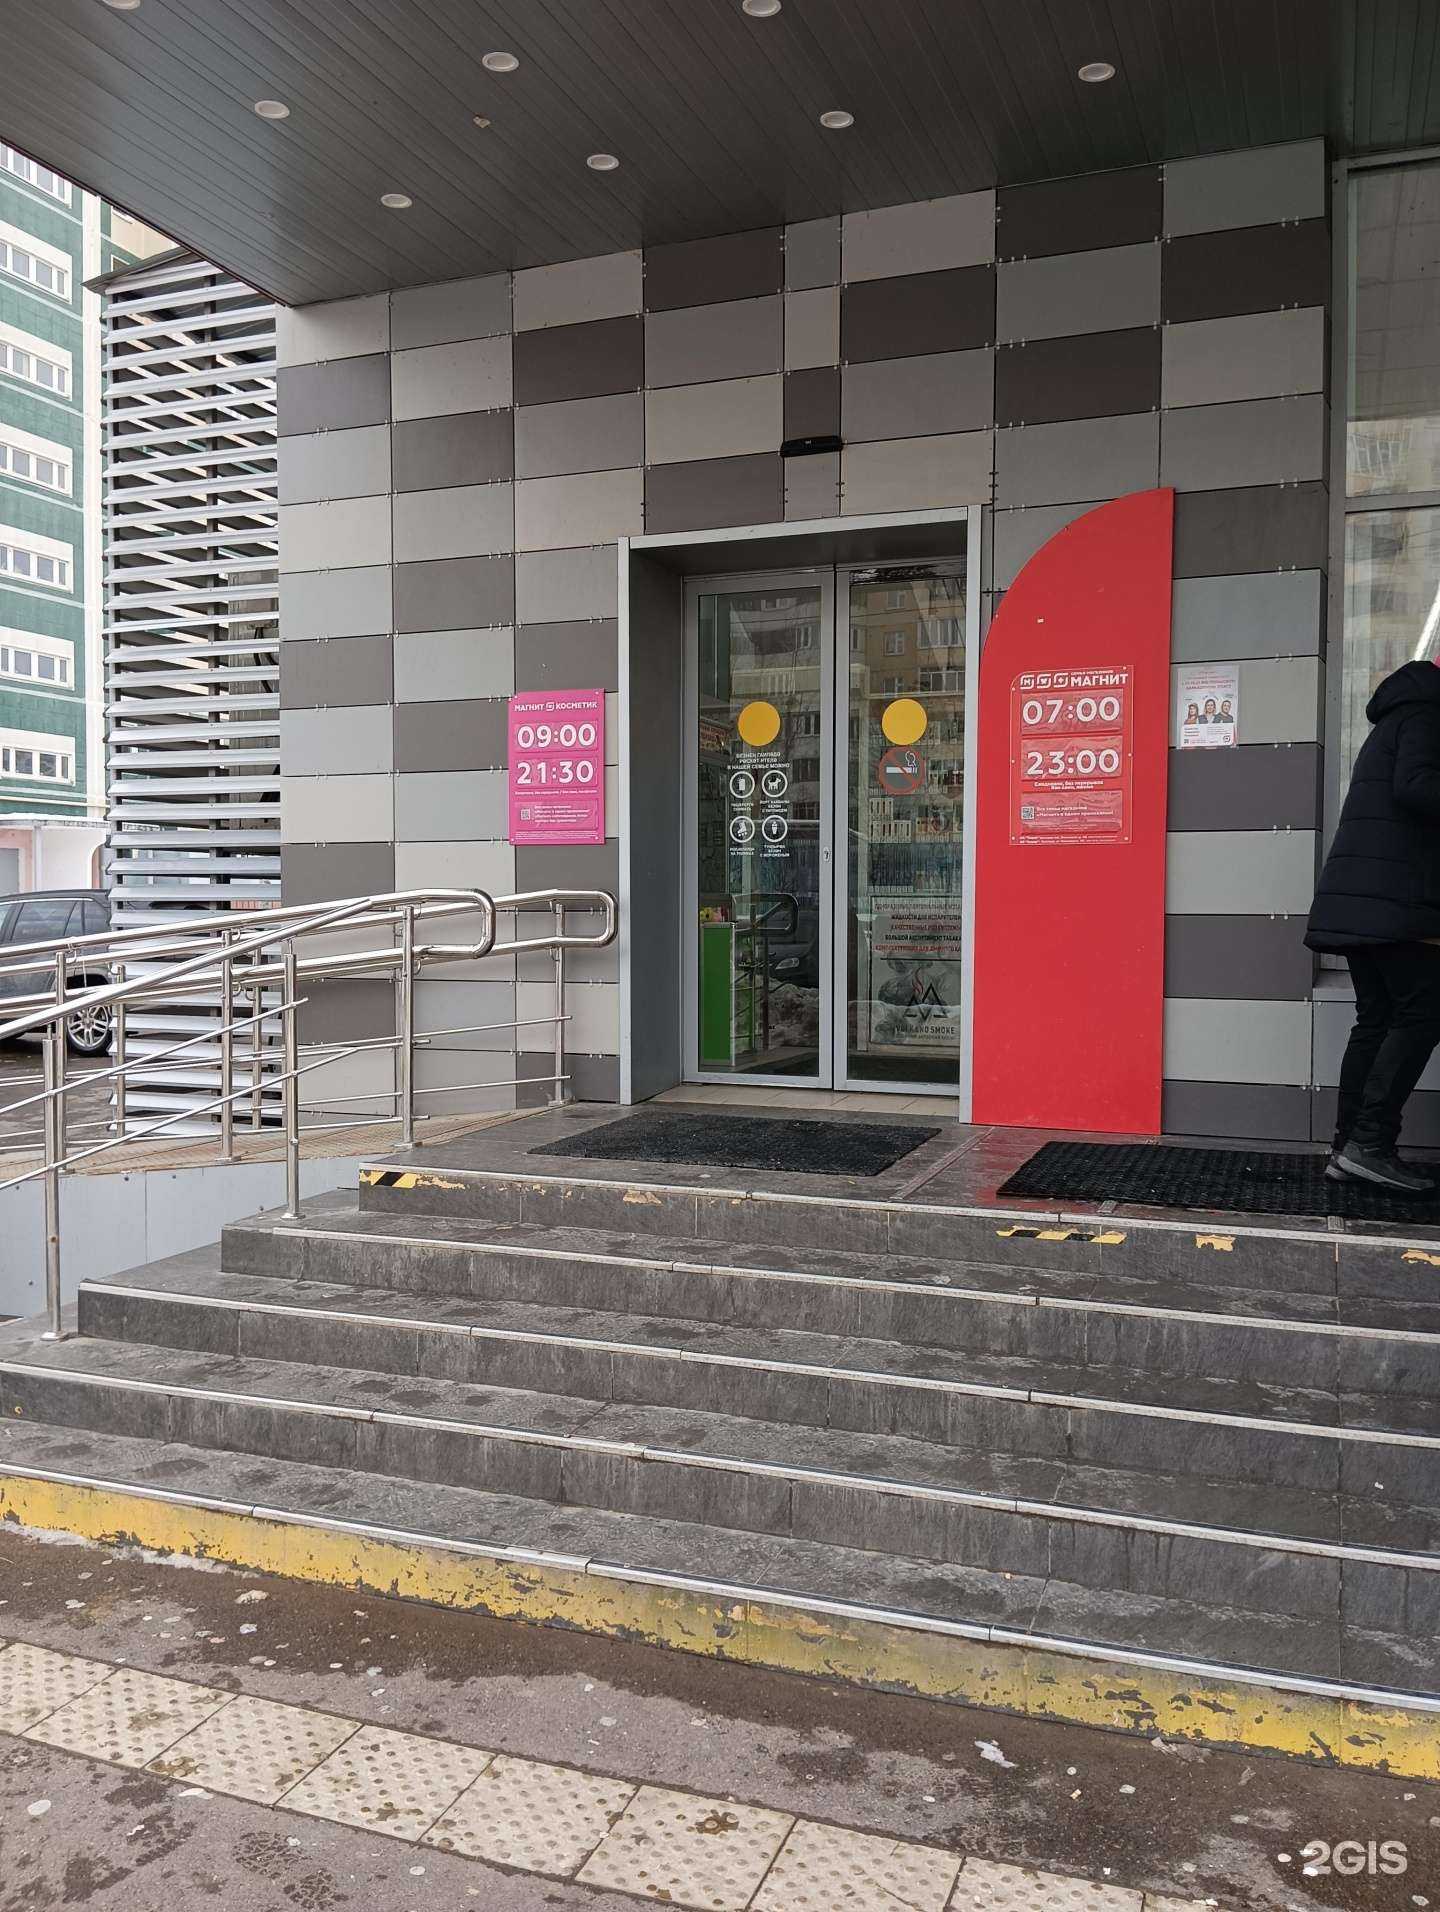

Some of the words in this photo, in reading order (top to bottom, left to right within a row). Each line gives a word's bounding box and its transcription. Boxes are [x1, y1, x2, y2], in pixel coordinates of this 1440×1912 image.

[1070, 673, 1129, 688] МАГНИТ
[514, 703, 545, 712] МАГНИТ
[555, 701, 598, 711] КОСМЕТИК
[1022, 696, 1120, 725] 07:00
[517, 723, 596, 748] 09:00
[517, 760, 594, 785] 21:30
[1026, 748, 1120, 775] 23:00
[930, 1025, 955, 1035] SMOKE
